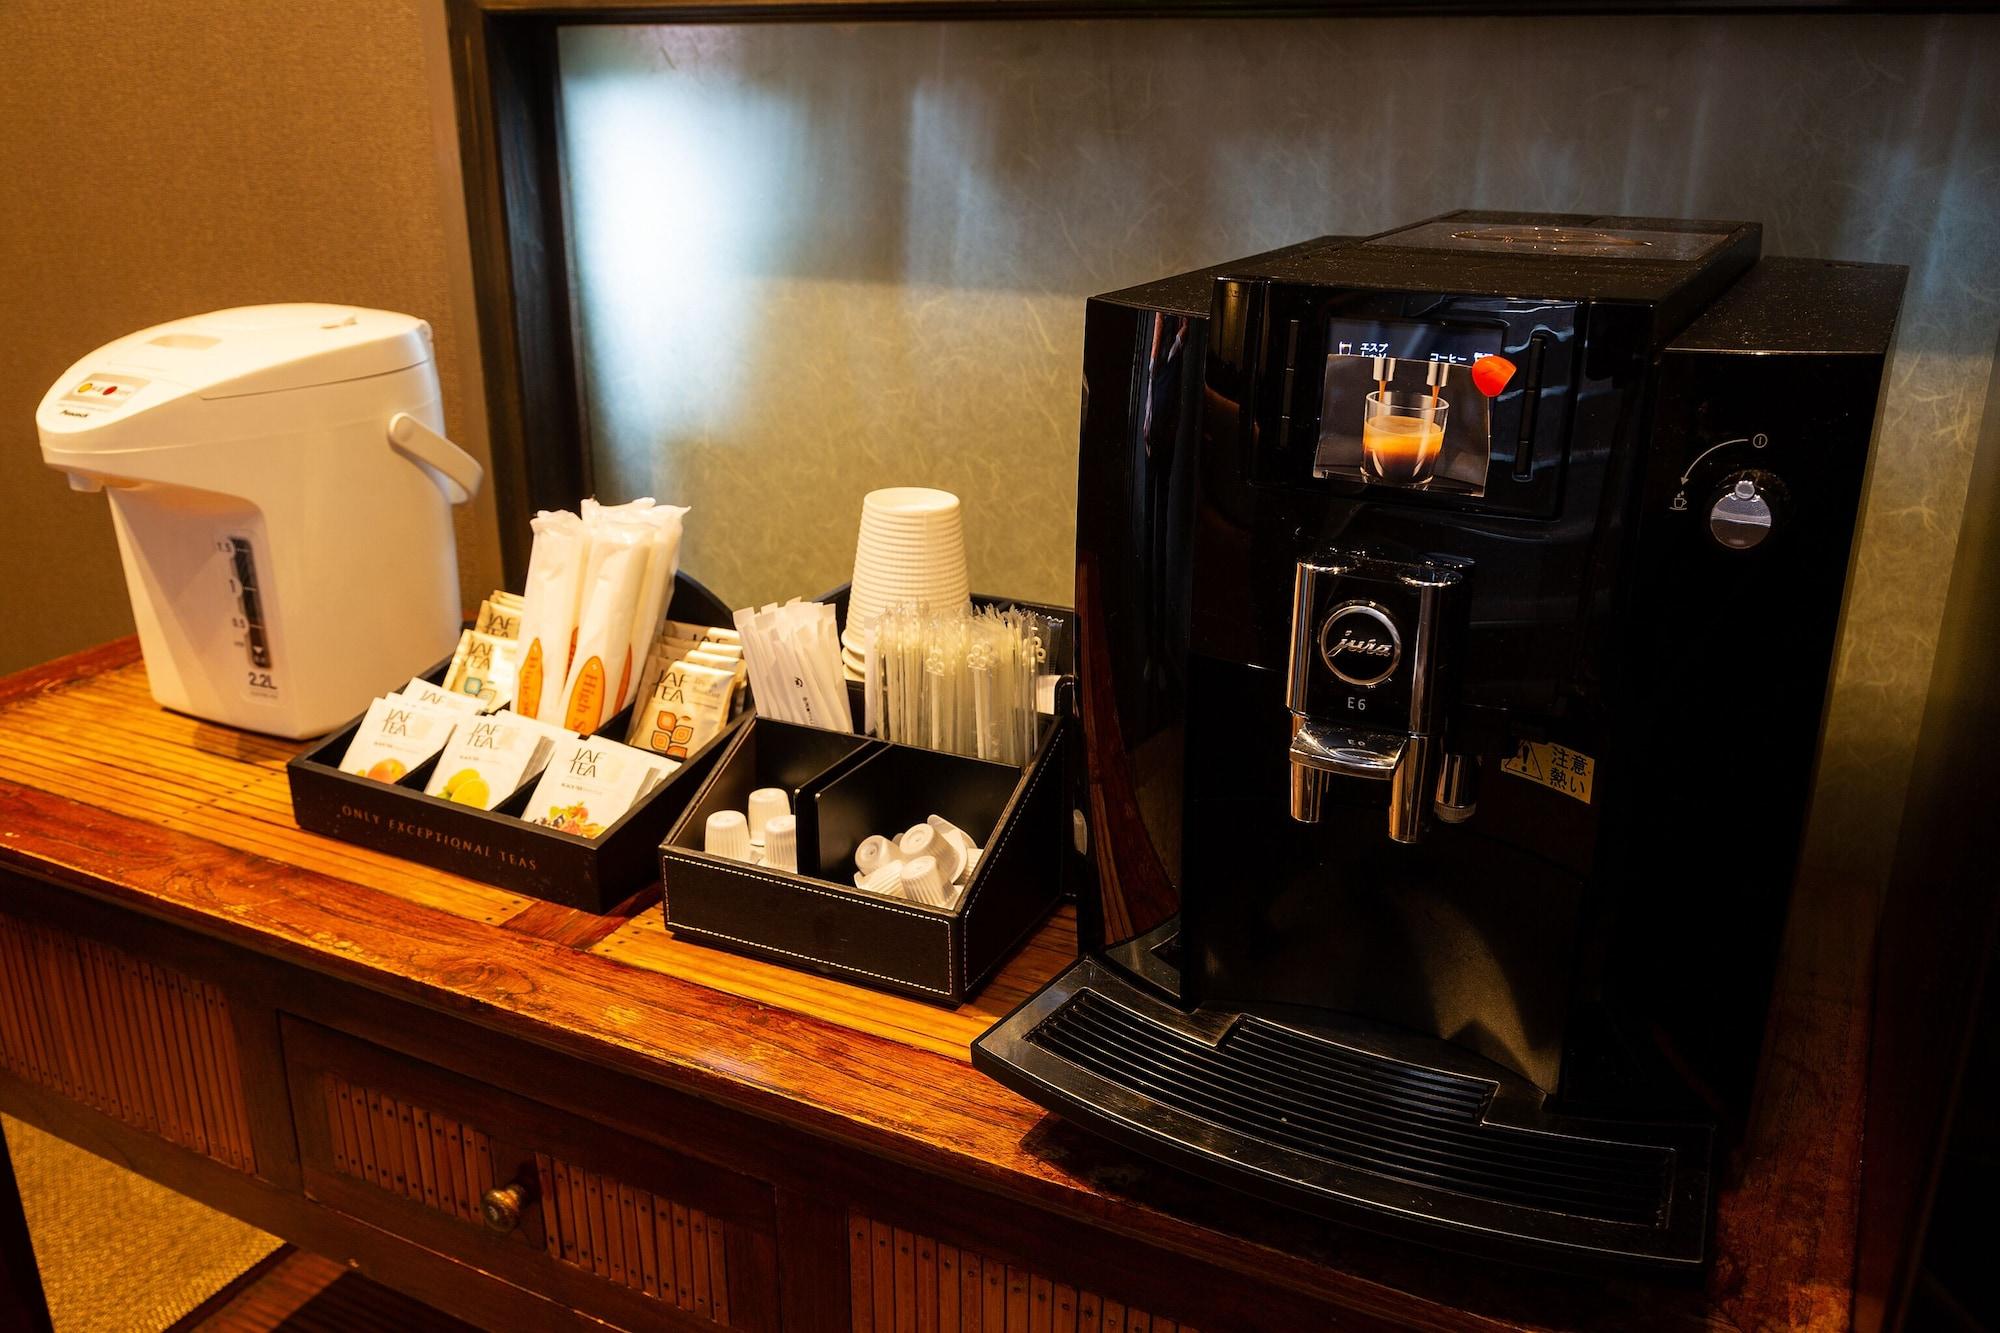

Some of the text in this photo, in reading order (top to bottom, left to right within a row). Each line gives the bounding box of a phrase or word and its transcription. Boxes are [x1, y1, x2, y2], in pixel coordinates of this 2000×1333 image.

[1360, 343, 1388, 352] エスプ
[1430, 353, 1467, 363] コーヒー
[488, 613, 515, 629] JAF
[1328, 630, 1392, 657] jura
[248, 672, 278, 690] 2.2L
[659, 670, 687, 687] JAF
[420, 690, 446, 704] JAF
[576, 674, 598, 713] High
[652, 683, 684, 704] TEA
[1347, 697, 1366, 711] E6
[386, 708, 415, 722] JAF
[382, 718, 406, 736] TEA
[472, 723, 503, 736] JAF
[467, 734, 493, 749] TEA
[573, 747, 608, 763] JAF
[1551, 745, 1588, 776] 注意
[569, 760, 596, 778] TEA
[1550, 767, 1585, 793] 熱い
[342, 805, 537, 871] ONLY EXCEPTIONAL TEAS
